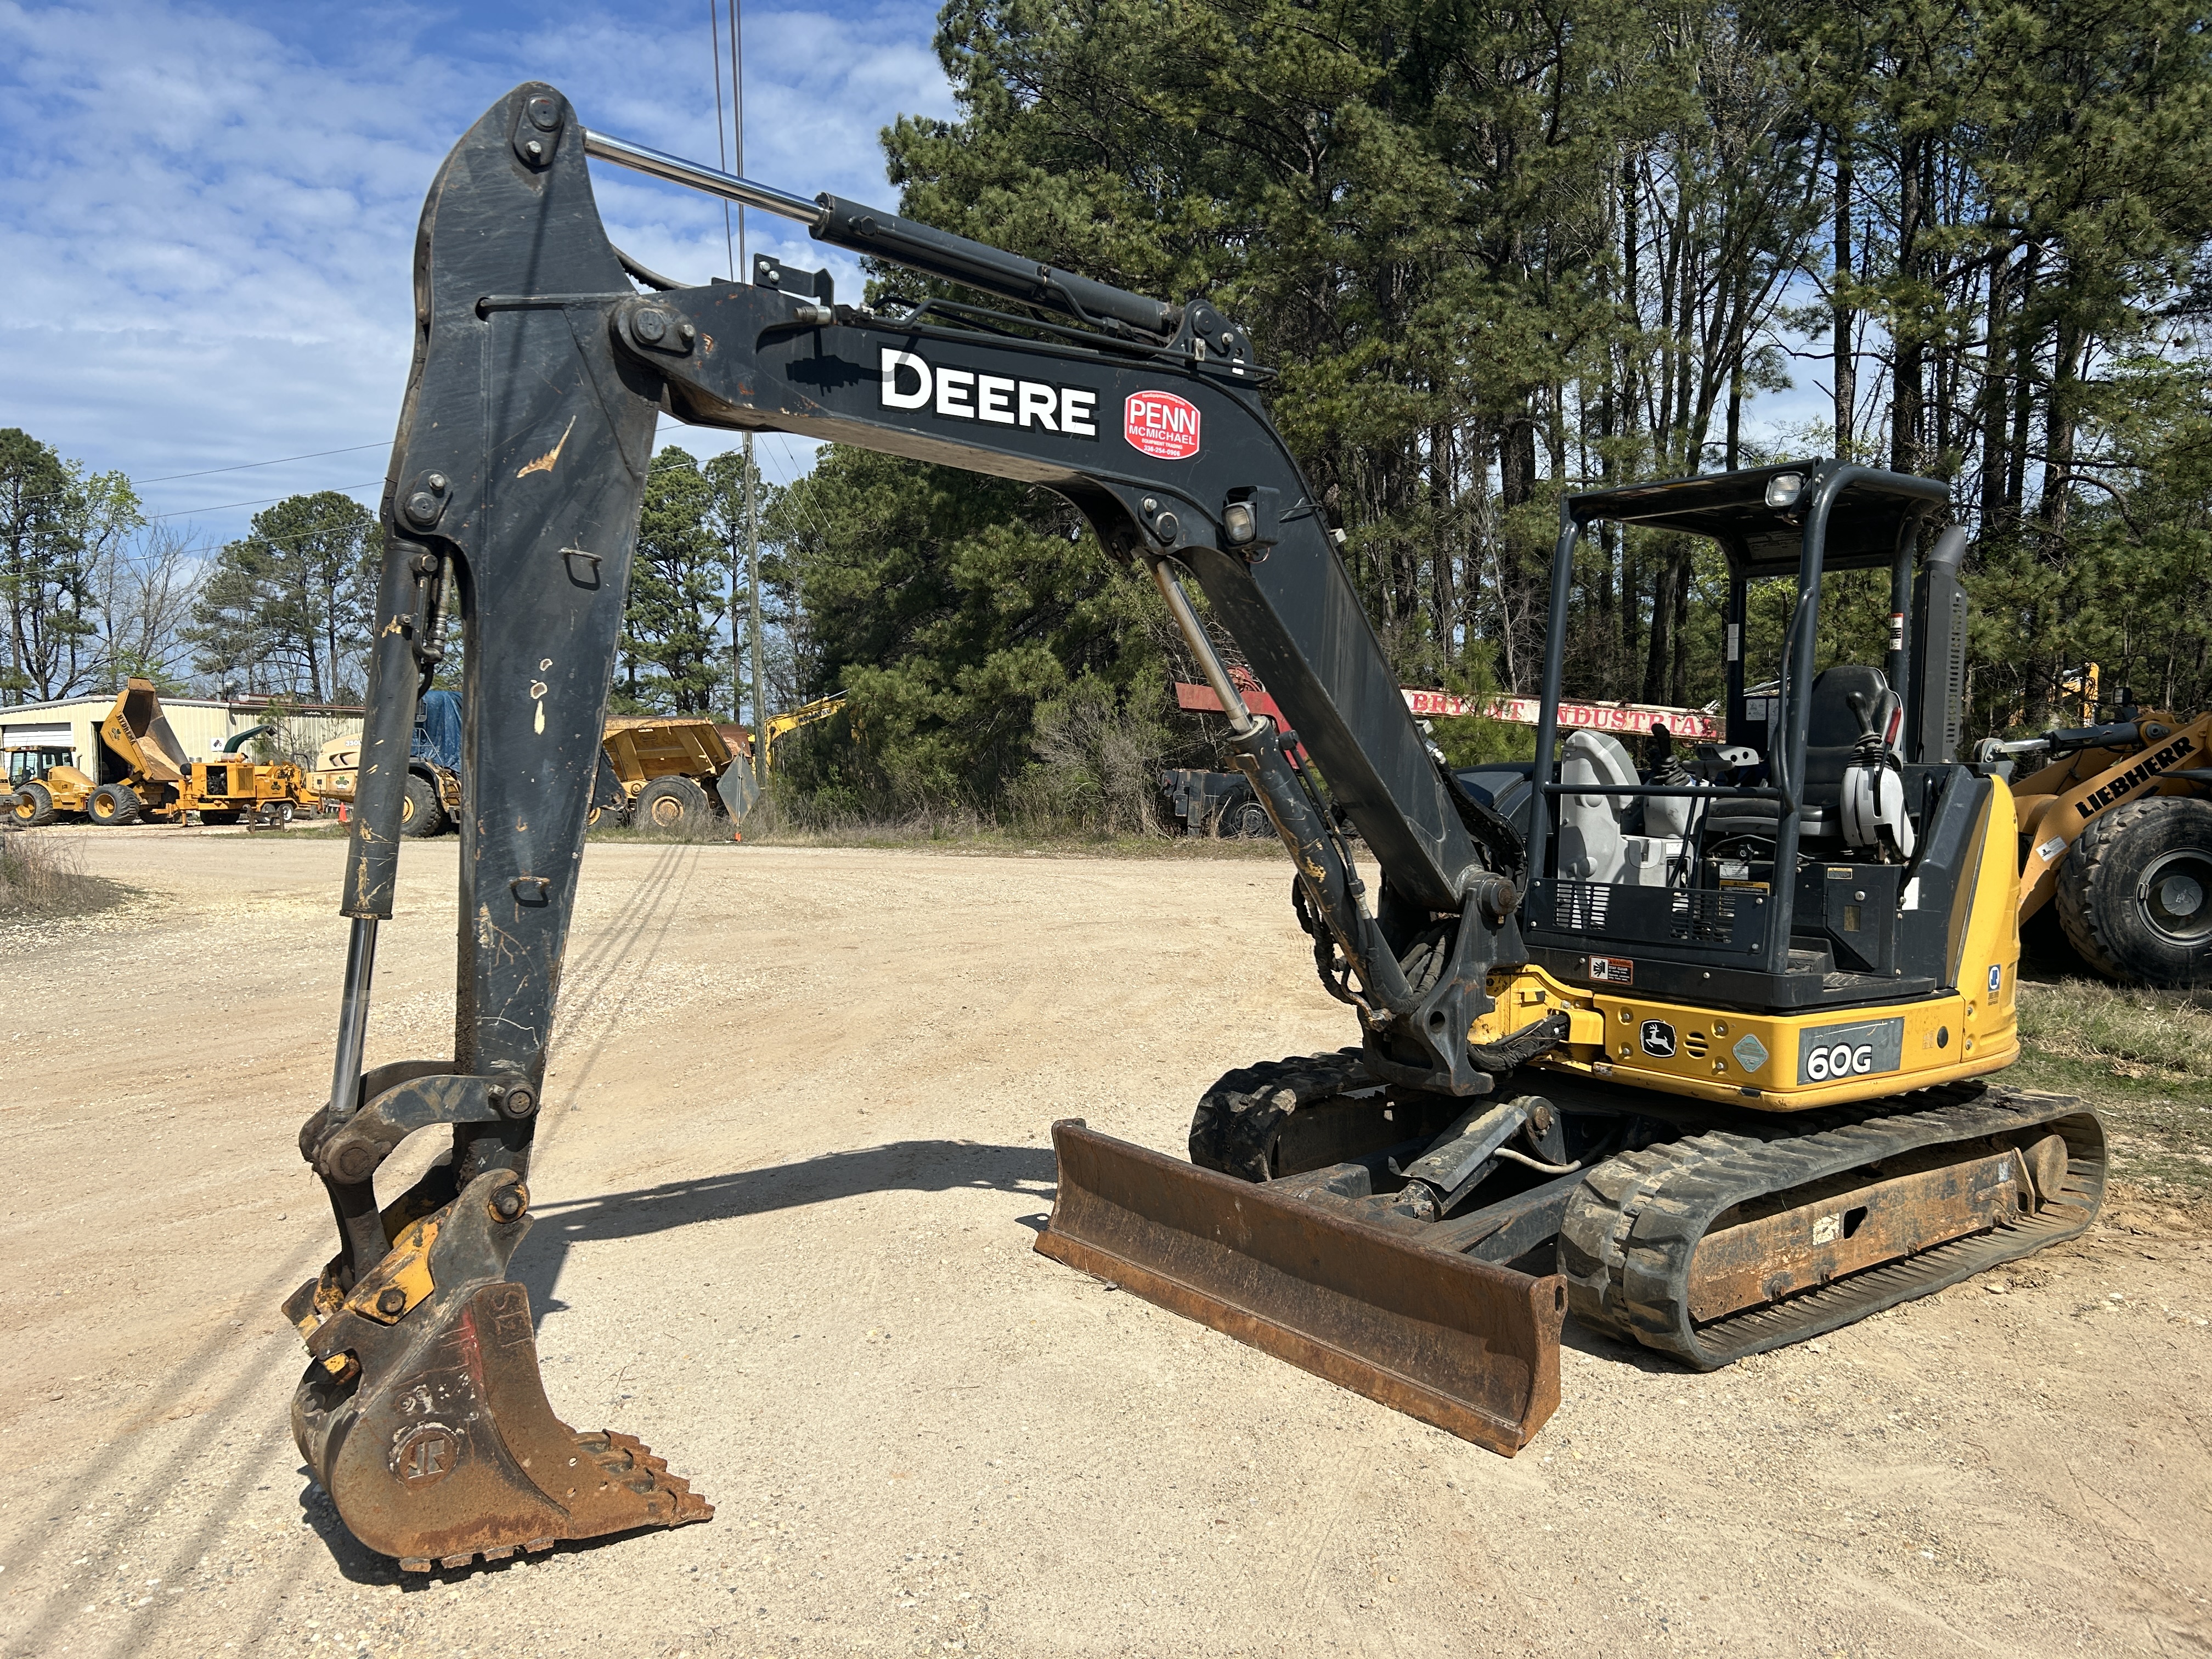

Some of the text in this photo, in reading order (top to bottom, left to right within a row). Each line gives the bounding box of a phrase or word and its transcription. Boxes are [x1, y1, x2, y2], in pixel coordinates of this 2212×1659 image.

[881, 347, 1096, 436] DEERE
[1129, 425, 1195, 445] MCMICHAEL
[1130, 398, 1195, 435] PENN
[117, 714, 137, 746] HYDREMA
[1557, 706, 1717, 737] NDUSTRIAL
[2075, 736, 2197, 819] LIEBHERR
[1807, 1042, 1872, 1081] 60G
